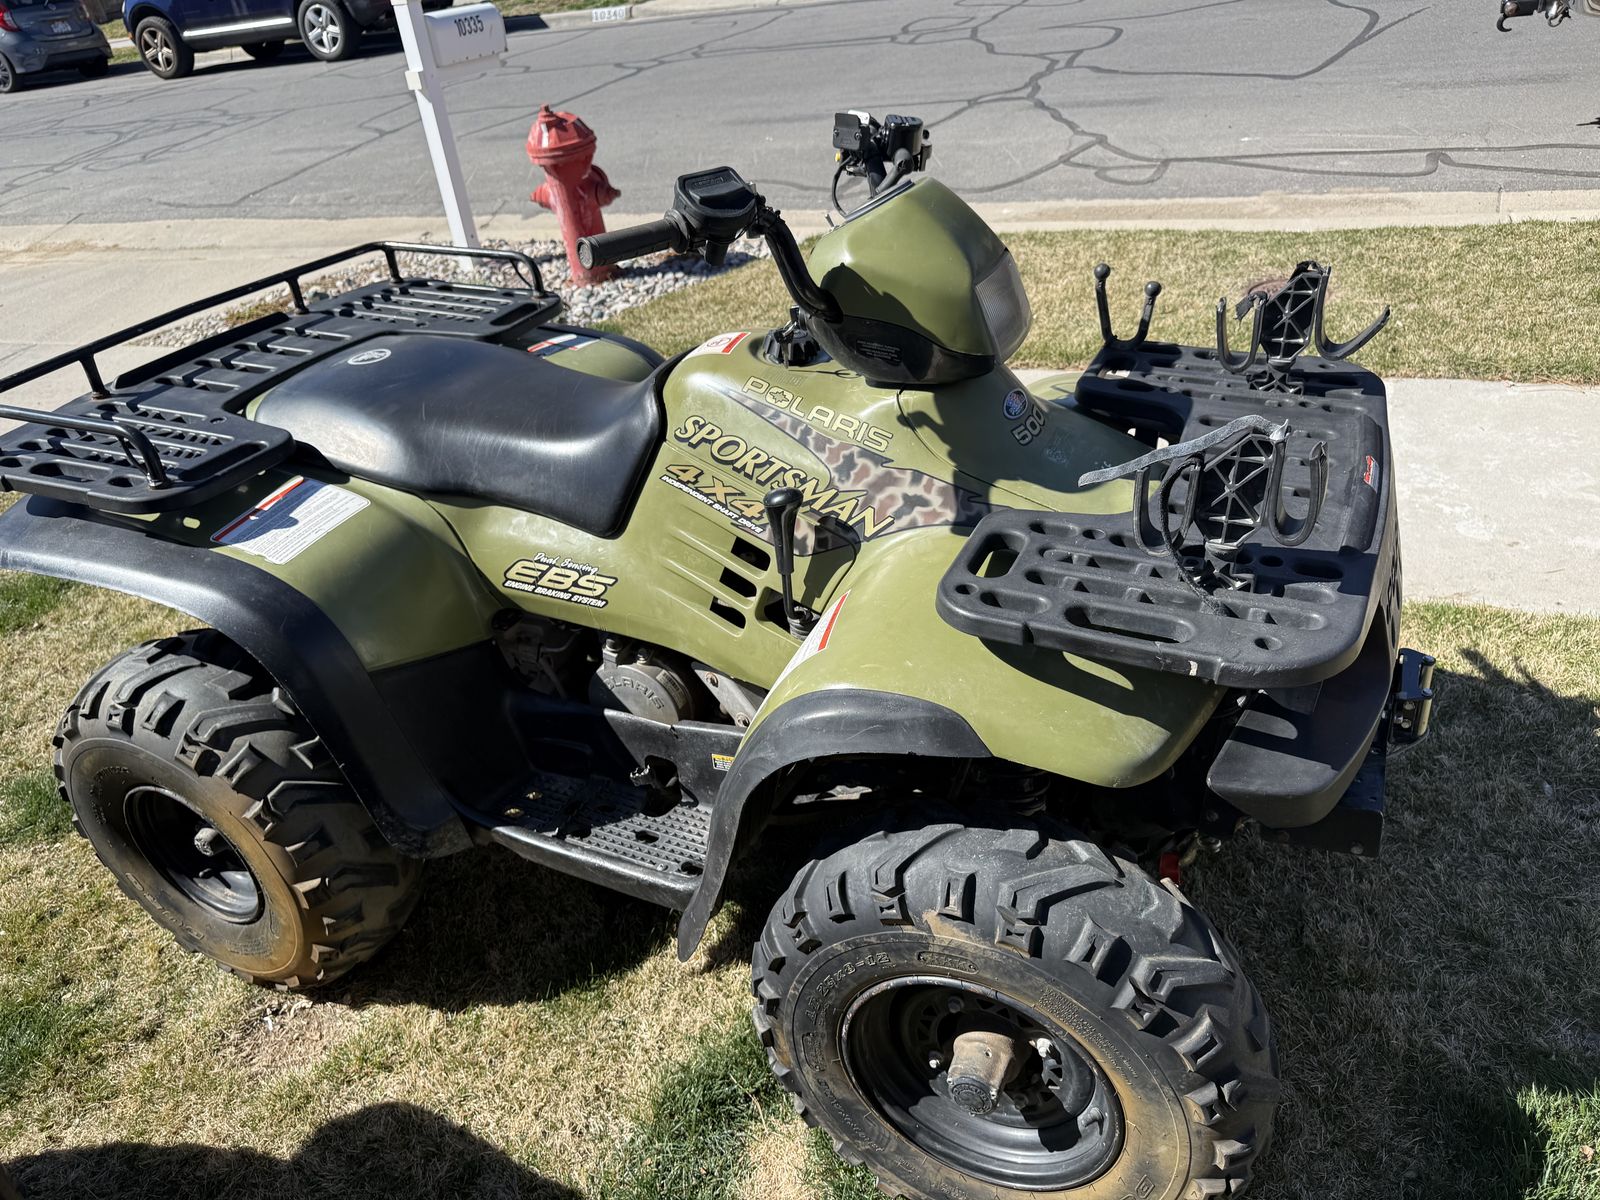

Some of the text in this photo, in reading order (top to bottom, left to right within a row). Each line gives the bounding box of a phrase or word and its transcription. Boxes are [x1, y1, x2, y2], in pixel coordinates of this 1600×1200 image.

[454, 15, 484, 37] 10335
[593, 8, 625, 21] 10340
[741, 376, 894, 452] POLARIS
[1011, 404, 1046, 446] 500
[665, 464, 766, 520] 4X4
[674, 415, 895, 541] SPORTSMAN
[660, 474, 764, 535] INDEPENDENT SHAFT DRIVE
[505, 559, 618, 598] EBS
[533, 551, 600, 575] Dual Sensing
[504, 579, 606, 609] ENGINE BRAKING SYSTEM
[603, 675, 665, 710] OLARIS
